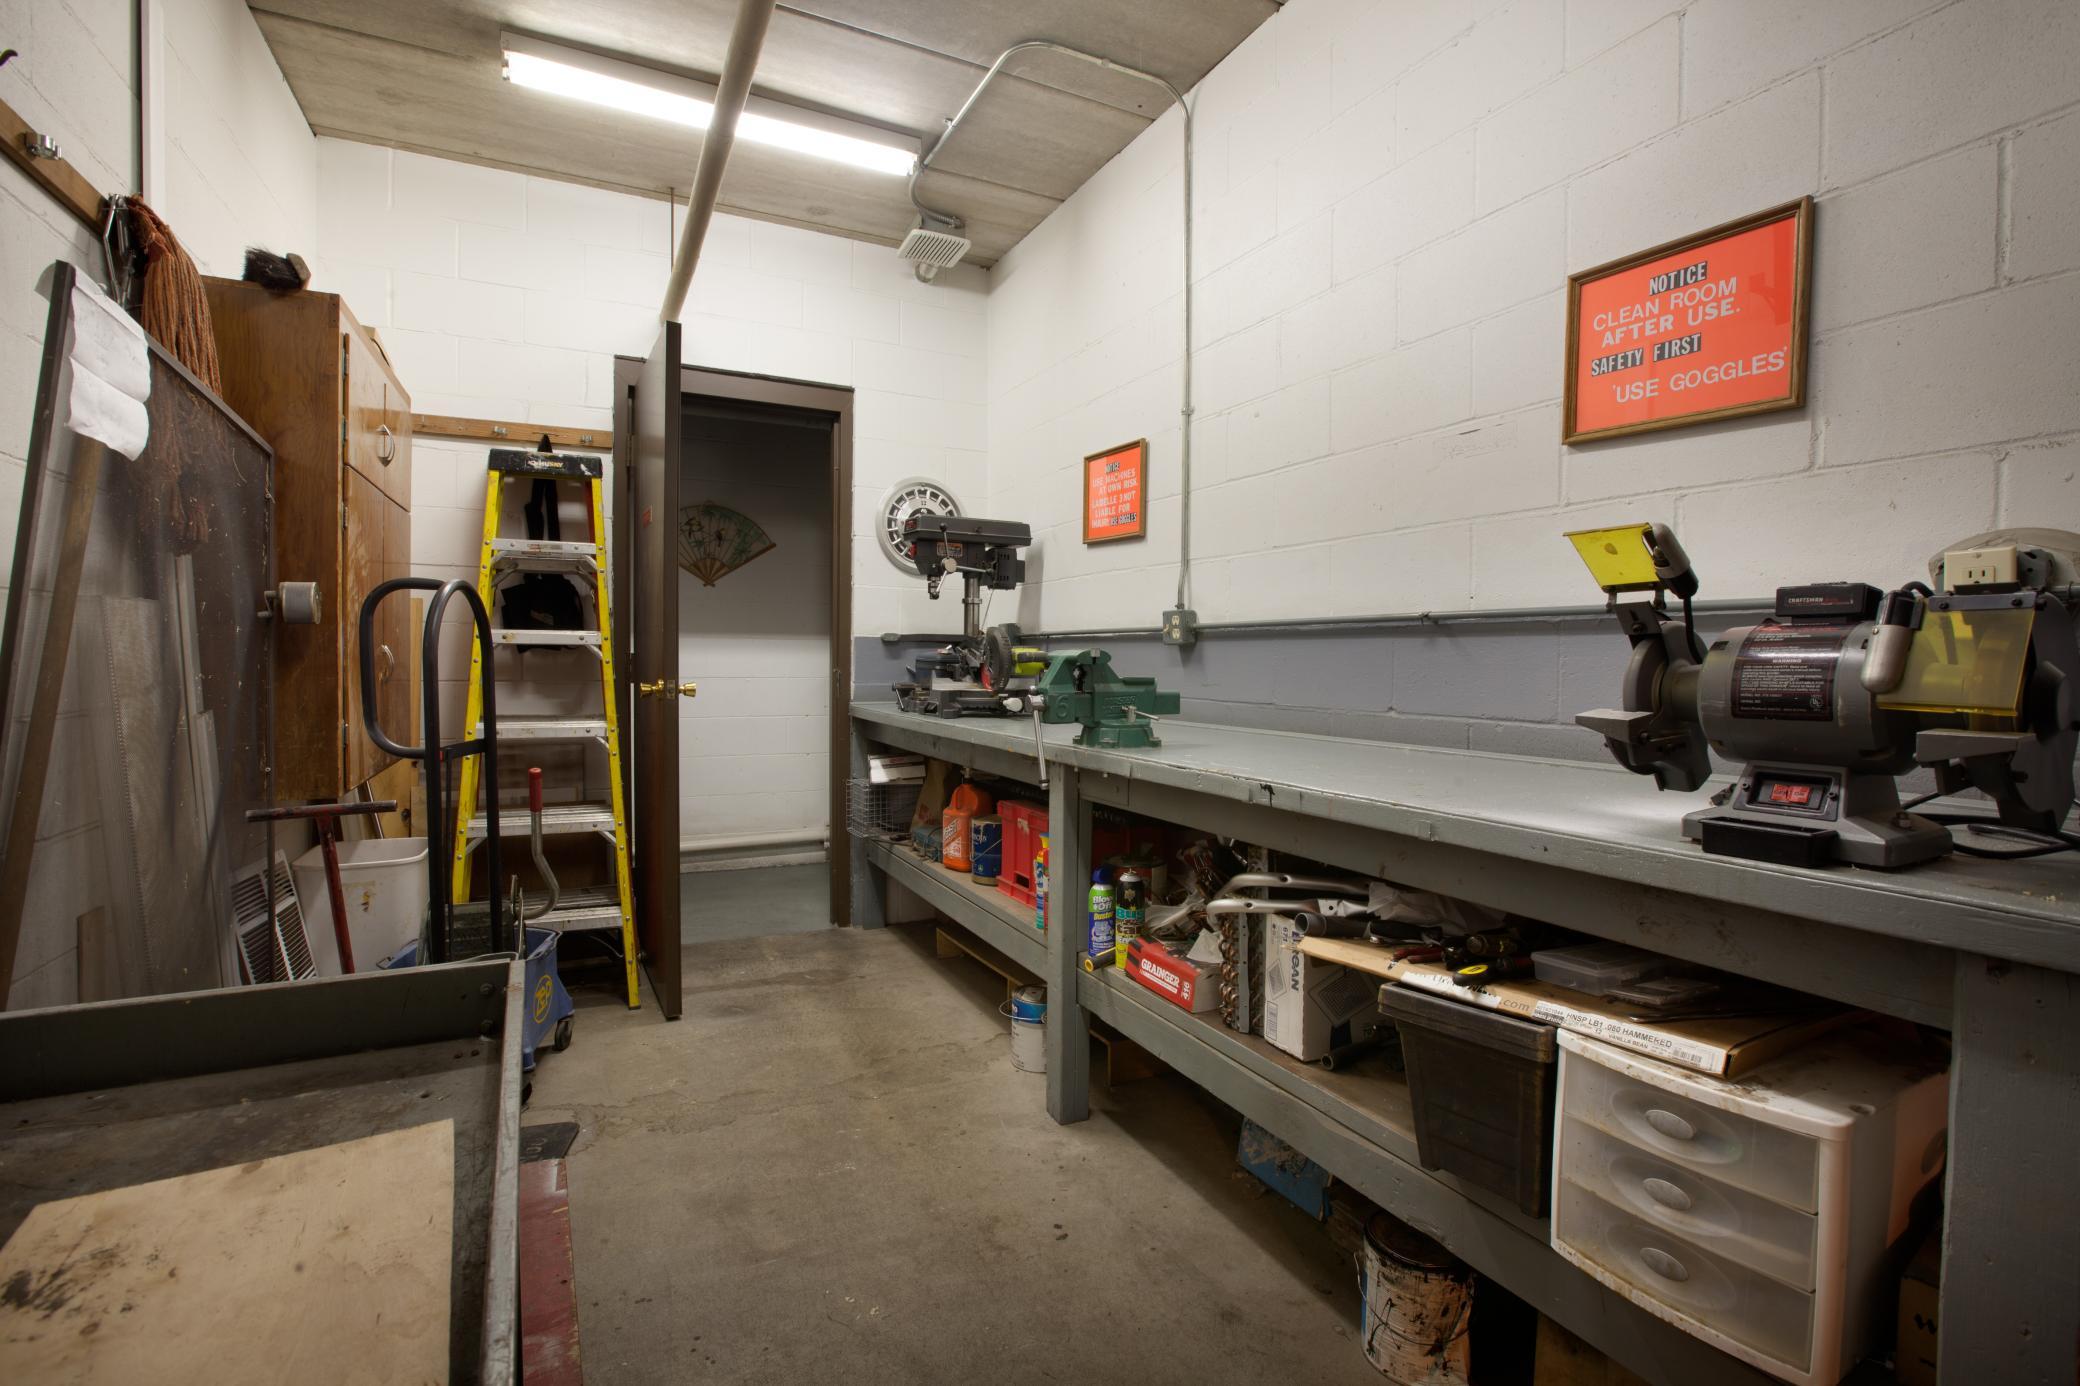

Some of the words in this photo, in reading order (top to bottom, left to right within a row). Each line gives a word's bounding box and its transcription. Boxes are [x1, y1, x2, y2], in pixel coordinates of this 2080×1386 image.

[1650, 261, 1707, 295] NOTICE
[1593, 299, 1659, 331] CLEAN
[1670, 277, 1737, 310] ROOM
[1602, 314, 1673, 348] AFTER
[1688, 298, 1740, 326] USE.
[1592, 348, 1643, 376] SAFETY
[1653, 333, 1701, 362] FIRST
[1056, 695, 1069, 719] 6
[1141, 958, 1180, 988] GRAINGER
[1566, 1012, 1588, 1024] HNSP
[1622, 1028, 1673, 1048] HAMMERED
